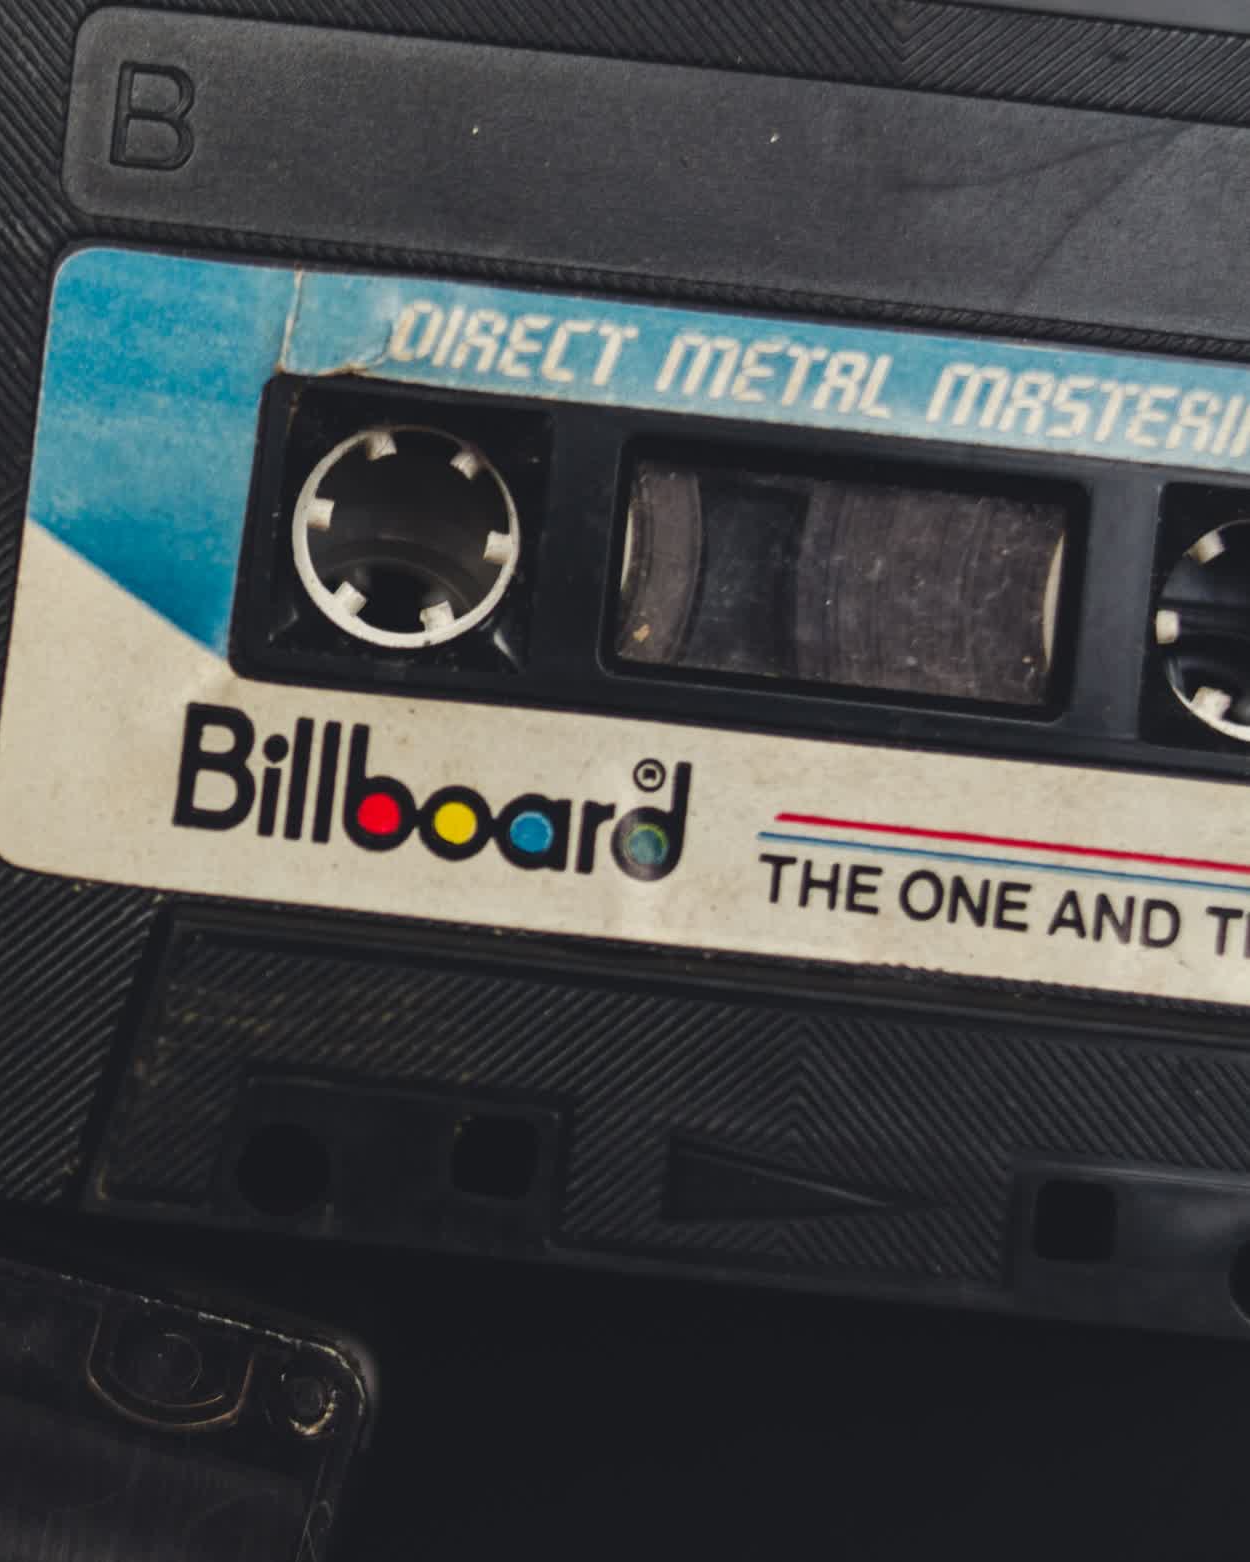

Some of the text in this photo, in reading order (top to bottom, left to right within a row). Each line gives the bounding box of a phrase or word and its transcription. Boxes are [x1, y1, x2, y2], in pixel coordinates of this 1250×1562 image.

[109, 60, 194, 171] B
[389, 300, 639, 387] DIRECT
[655, 332, 892, 419] METAL
[172, 701, 692, 882] Billboard
[760, 854, 883, 915] THE
[899, 870, 1032, 932] ONE
[1047, 890, 1181, 949] AND
